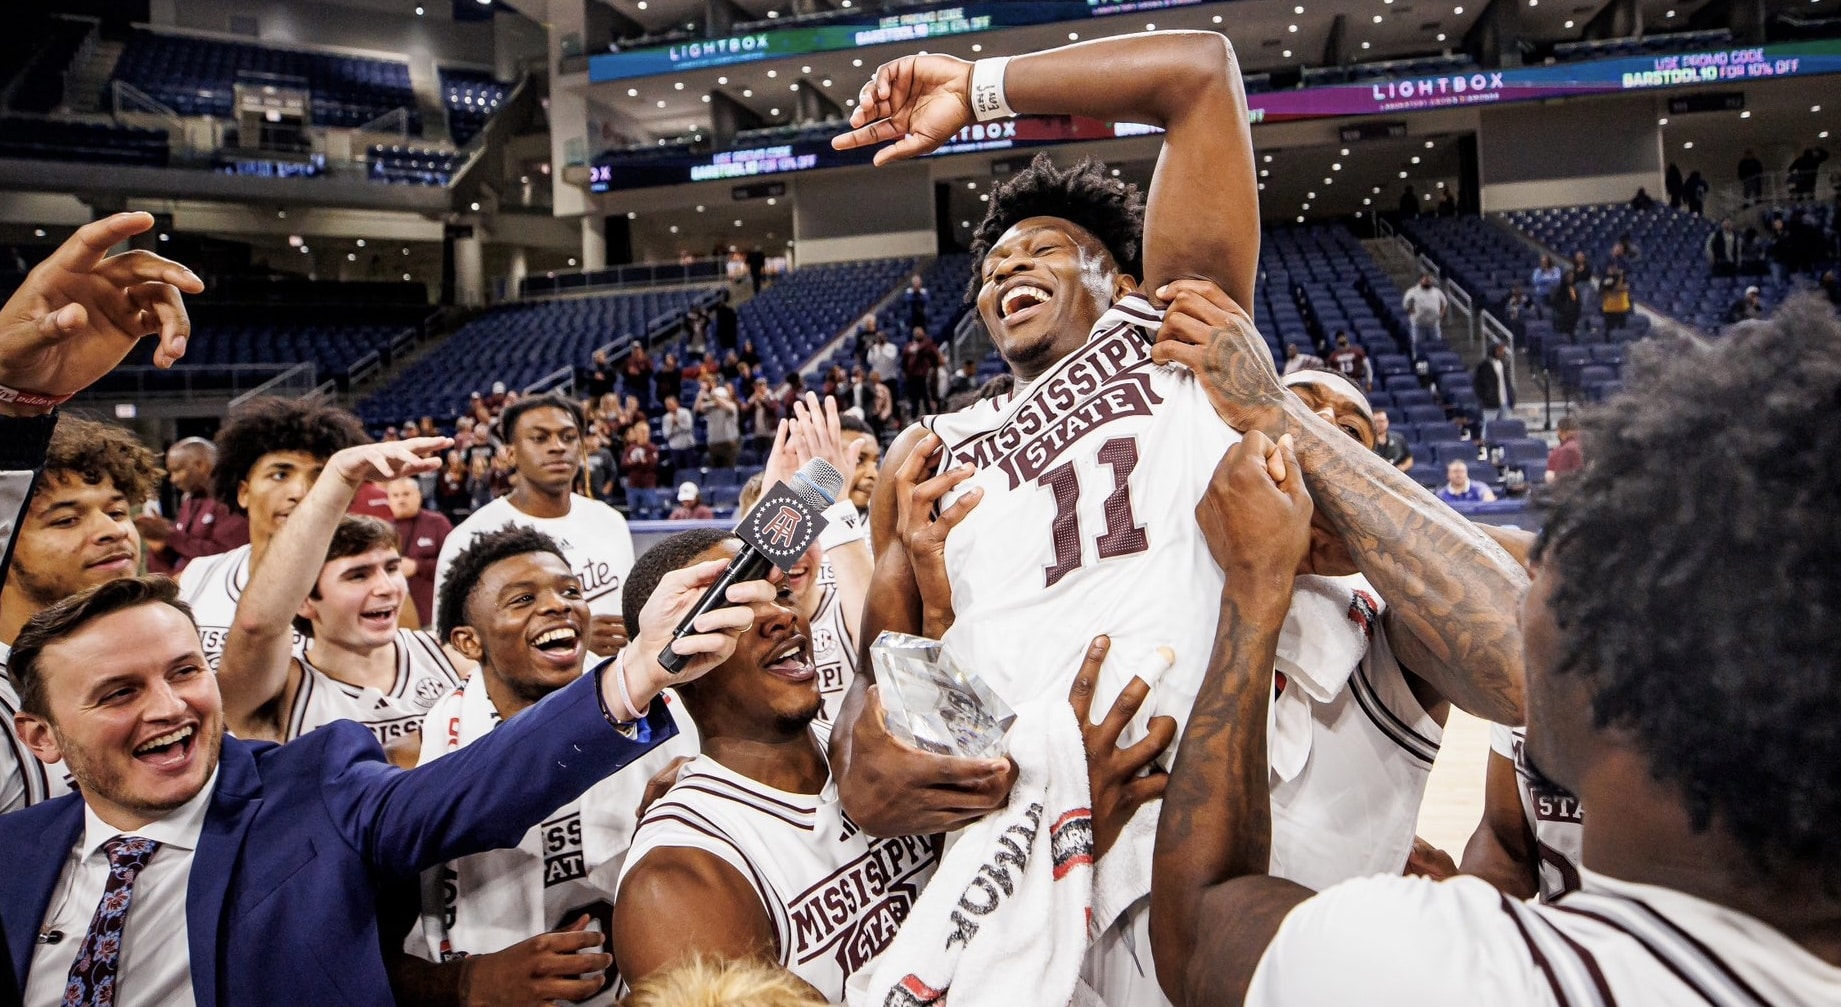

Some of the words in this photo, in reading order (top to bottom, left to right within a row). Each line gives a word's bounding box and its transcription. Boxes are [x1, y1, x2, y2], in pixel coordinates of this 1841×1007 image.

[669, 33, 769, 62] LIGHTBOX
[1655, 56, 1679, 70] USE
[1731, 48, 1764, 65] CODE
[1775, 58, 1799, 75] OFF
[1373, 72, 1504, 100] LIGHTBOX
[1026, 388, 1136, 469] STATE
[1036, 435, 1151, 590] 11
[1539, 795, 1584, 819] STA
